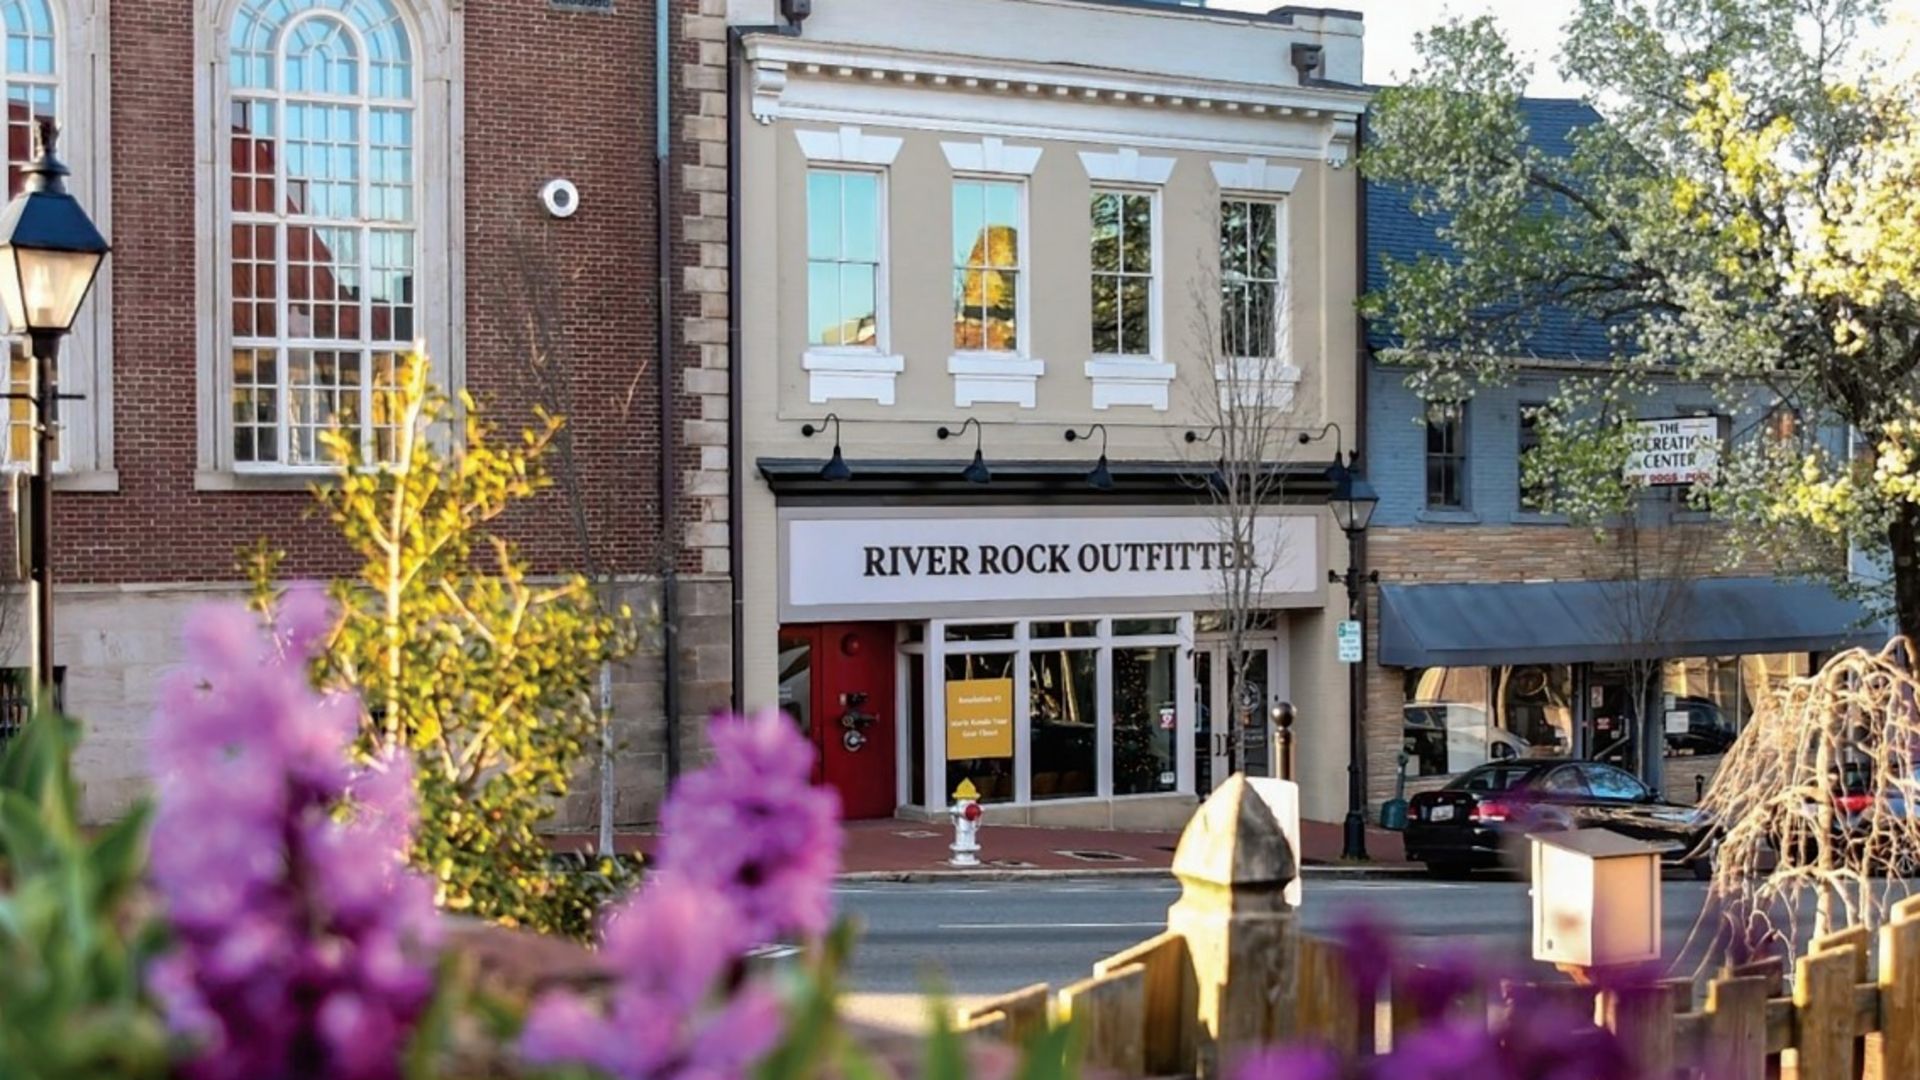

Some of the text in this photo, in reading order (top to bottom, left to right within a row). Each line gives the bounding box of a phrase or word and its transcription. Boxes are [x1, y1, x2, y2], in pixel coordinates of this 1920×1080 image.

[1659, 422, 1680, 434] THE
[1643, 453, 1696, 468] CENTER
[863, 542, 1258, 576] RIVER ROCK OUTFITTER
